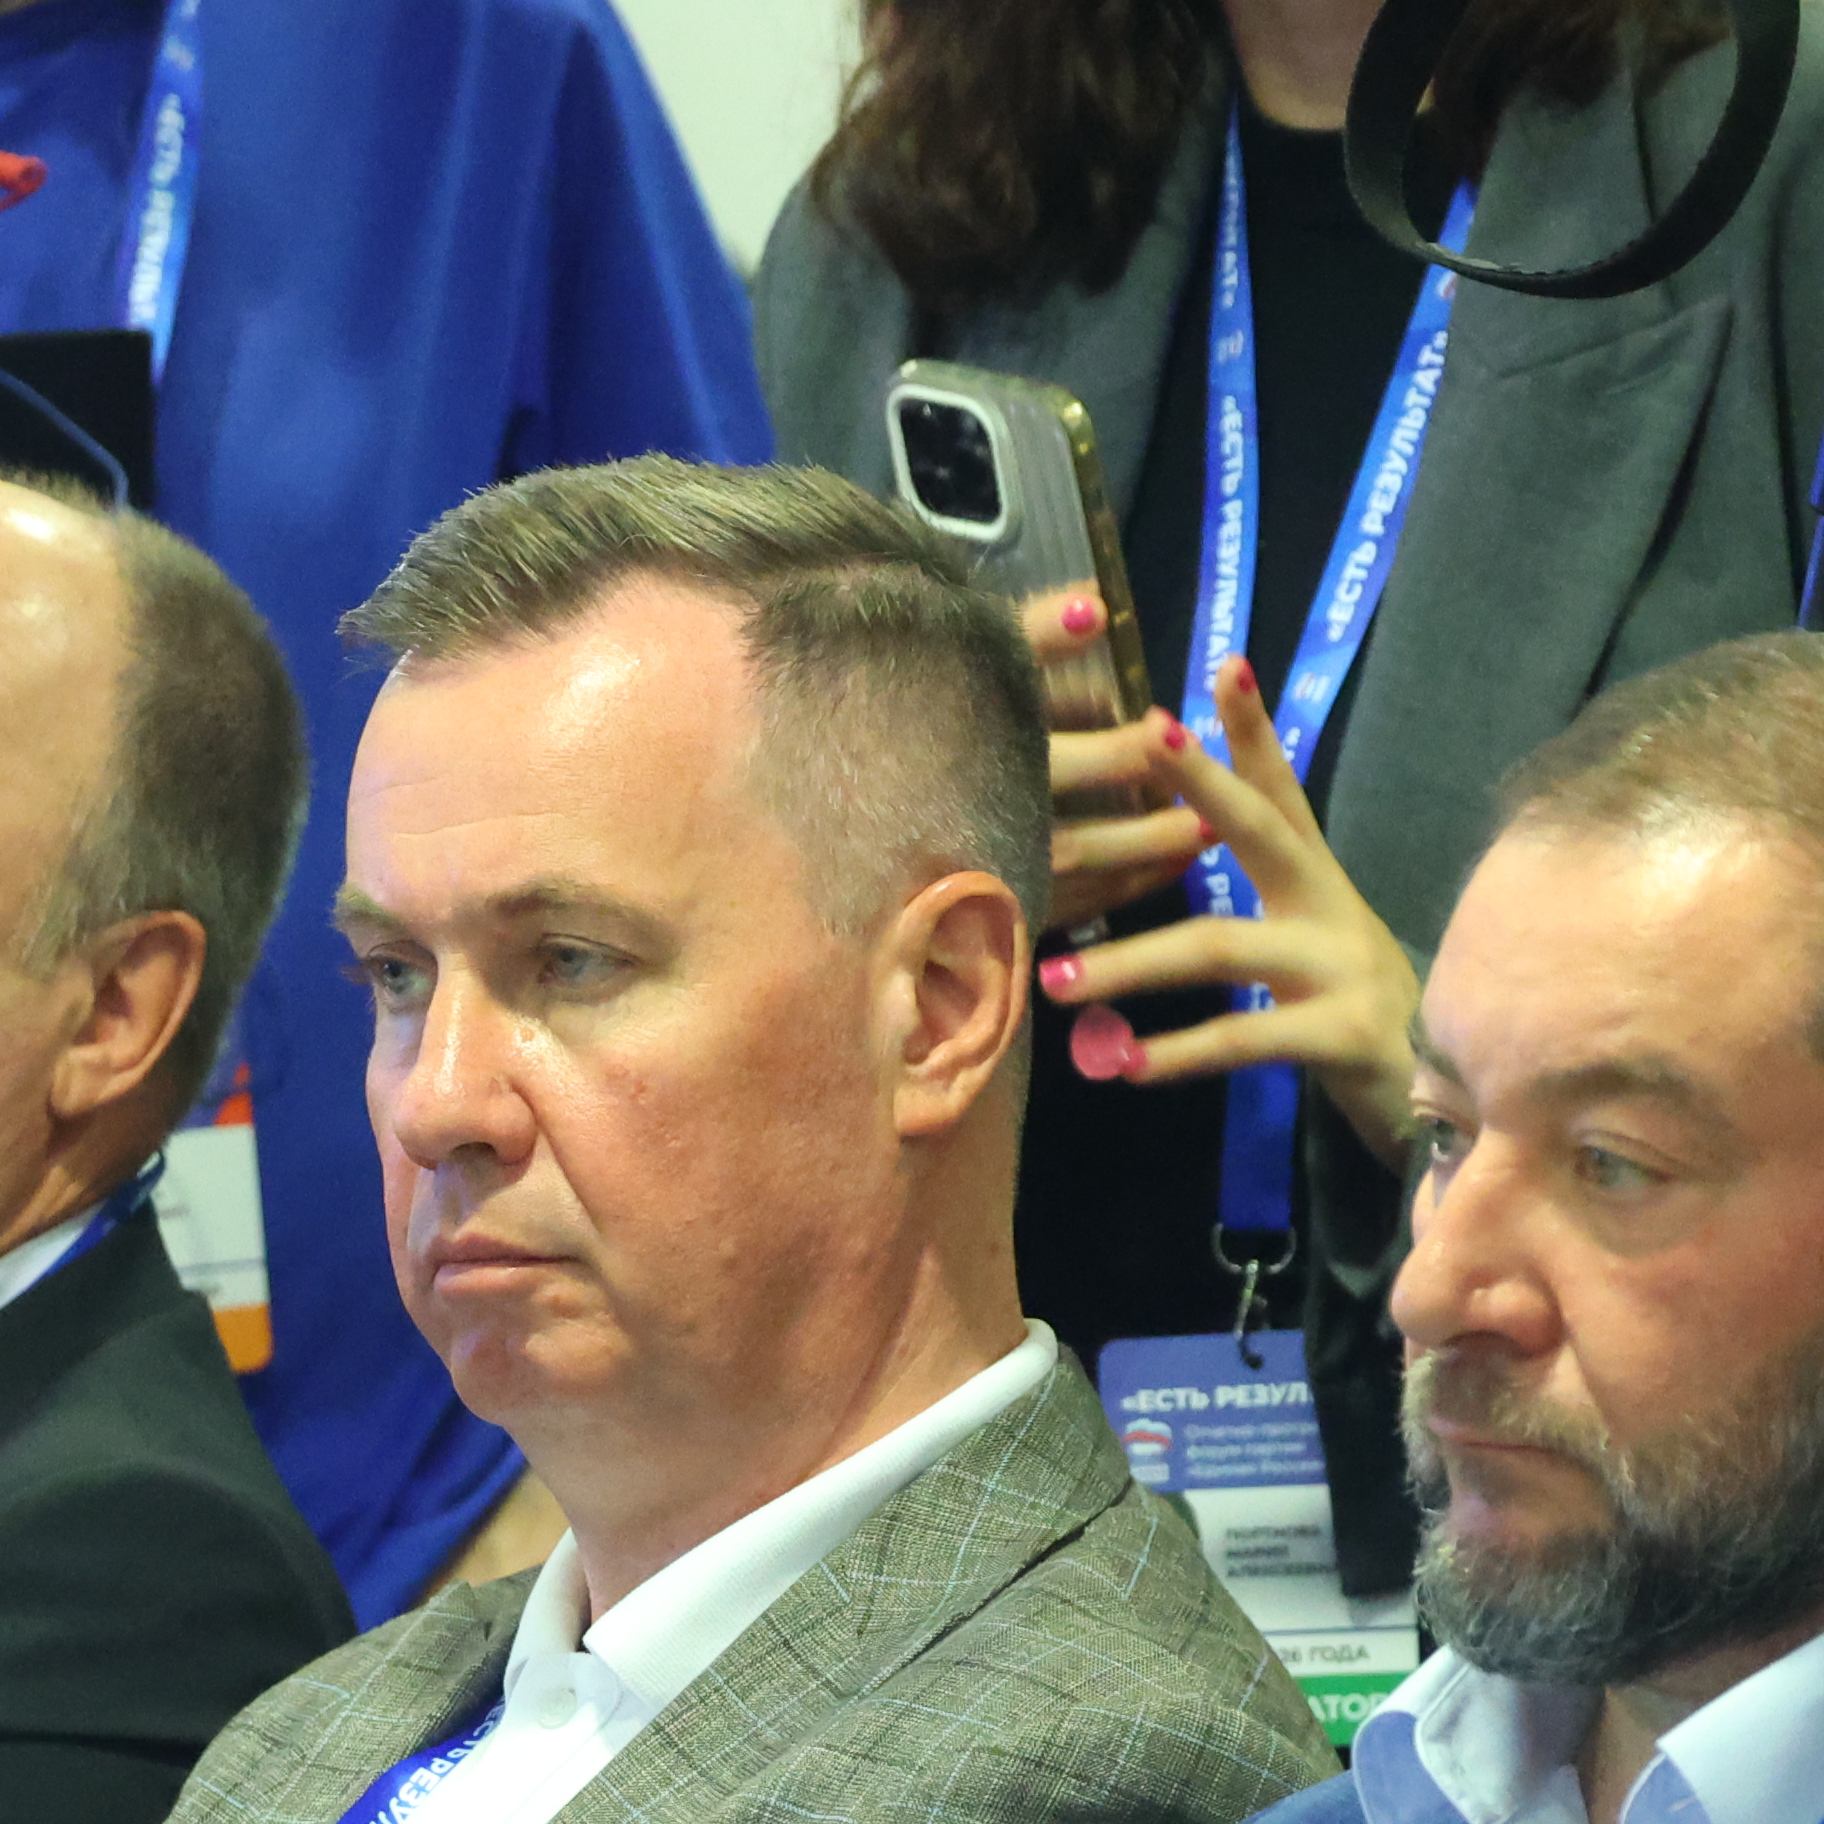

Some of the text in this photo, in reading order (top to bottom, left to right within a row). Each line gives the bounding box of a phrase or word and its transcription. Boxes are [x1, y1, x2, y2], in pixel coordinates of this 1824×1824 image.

[1326, 329, 1449, 643] «ЕСТЬ РЕЗУЛЬТАТ»
[1121, 1386, 1210, 1413] «ЕСТЬ
